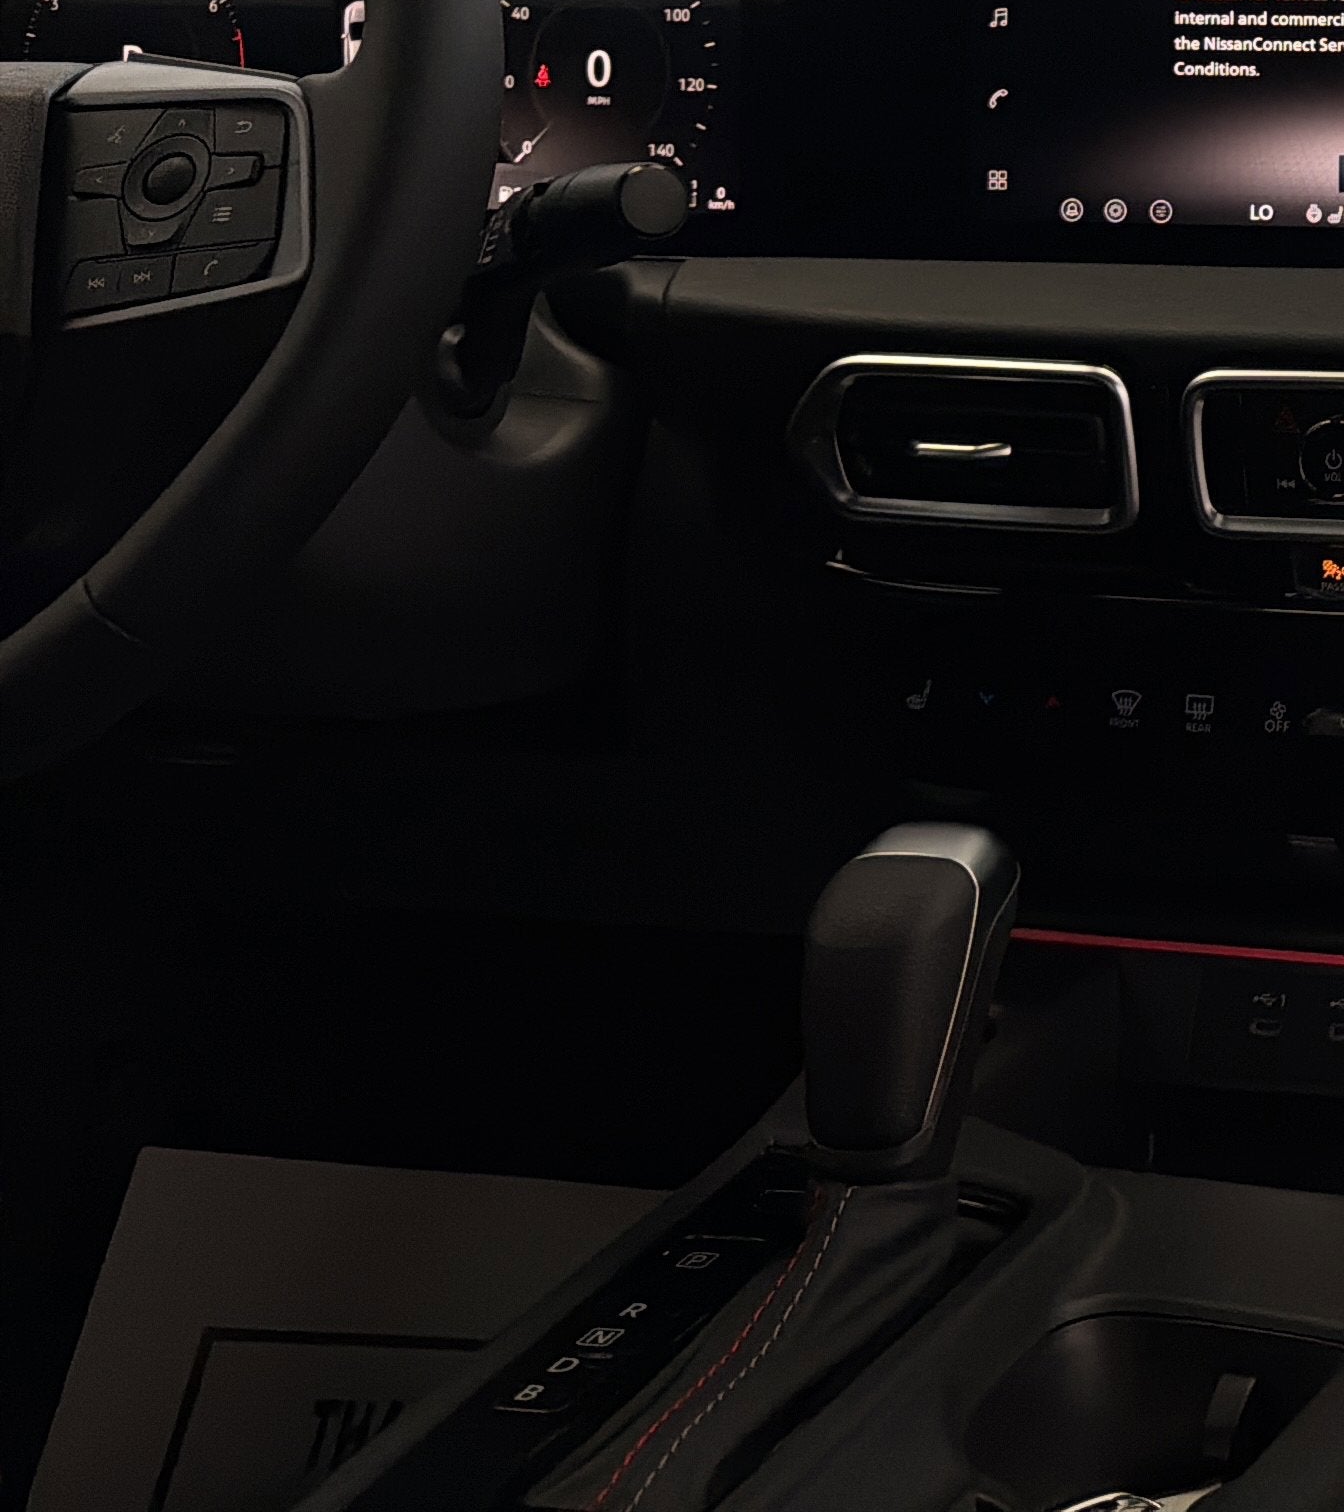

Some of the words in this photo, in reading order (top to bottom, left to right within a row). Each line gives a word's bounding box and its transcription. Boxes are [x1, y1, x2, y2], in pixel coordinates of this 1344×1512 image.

[208, 0, 218, 12] 6
[511, 7, 530, 20] 40
[664, 8, 690, 21] 100
[1173, 9, 1235, 27] internal
[1236, 9, 1268, 27] and
[1172, 35, 1201, 52] the
[1202, 35, 1317, 53] NissanConnect
[585, 49, 612, 88] 0
[1172, 60, 1260, 78] Conditions.
[678, 77, 704, 91] 120
[586, 95, 611, 106] MPH
[522, 140, 533, 154] 0
[648, 143, 675, 157] 140
[716, 187, 726, 199] 0
[708, 200, 735, 211] km/h
[1249, 203, 1274, 222] LO
[1109, 717, 1141, 729] FRONT
[1185, 721, 1212, 734] REAR
[1263, 719, 1290, 734] OFF
[618, 1302, 648, 1319] R
[545, 1356, 581, 1373] D
[512, 1384, 546, 1402] B
